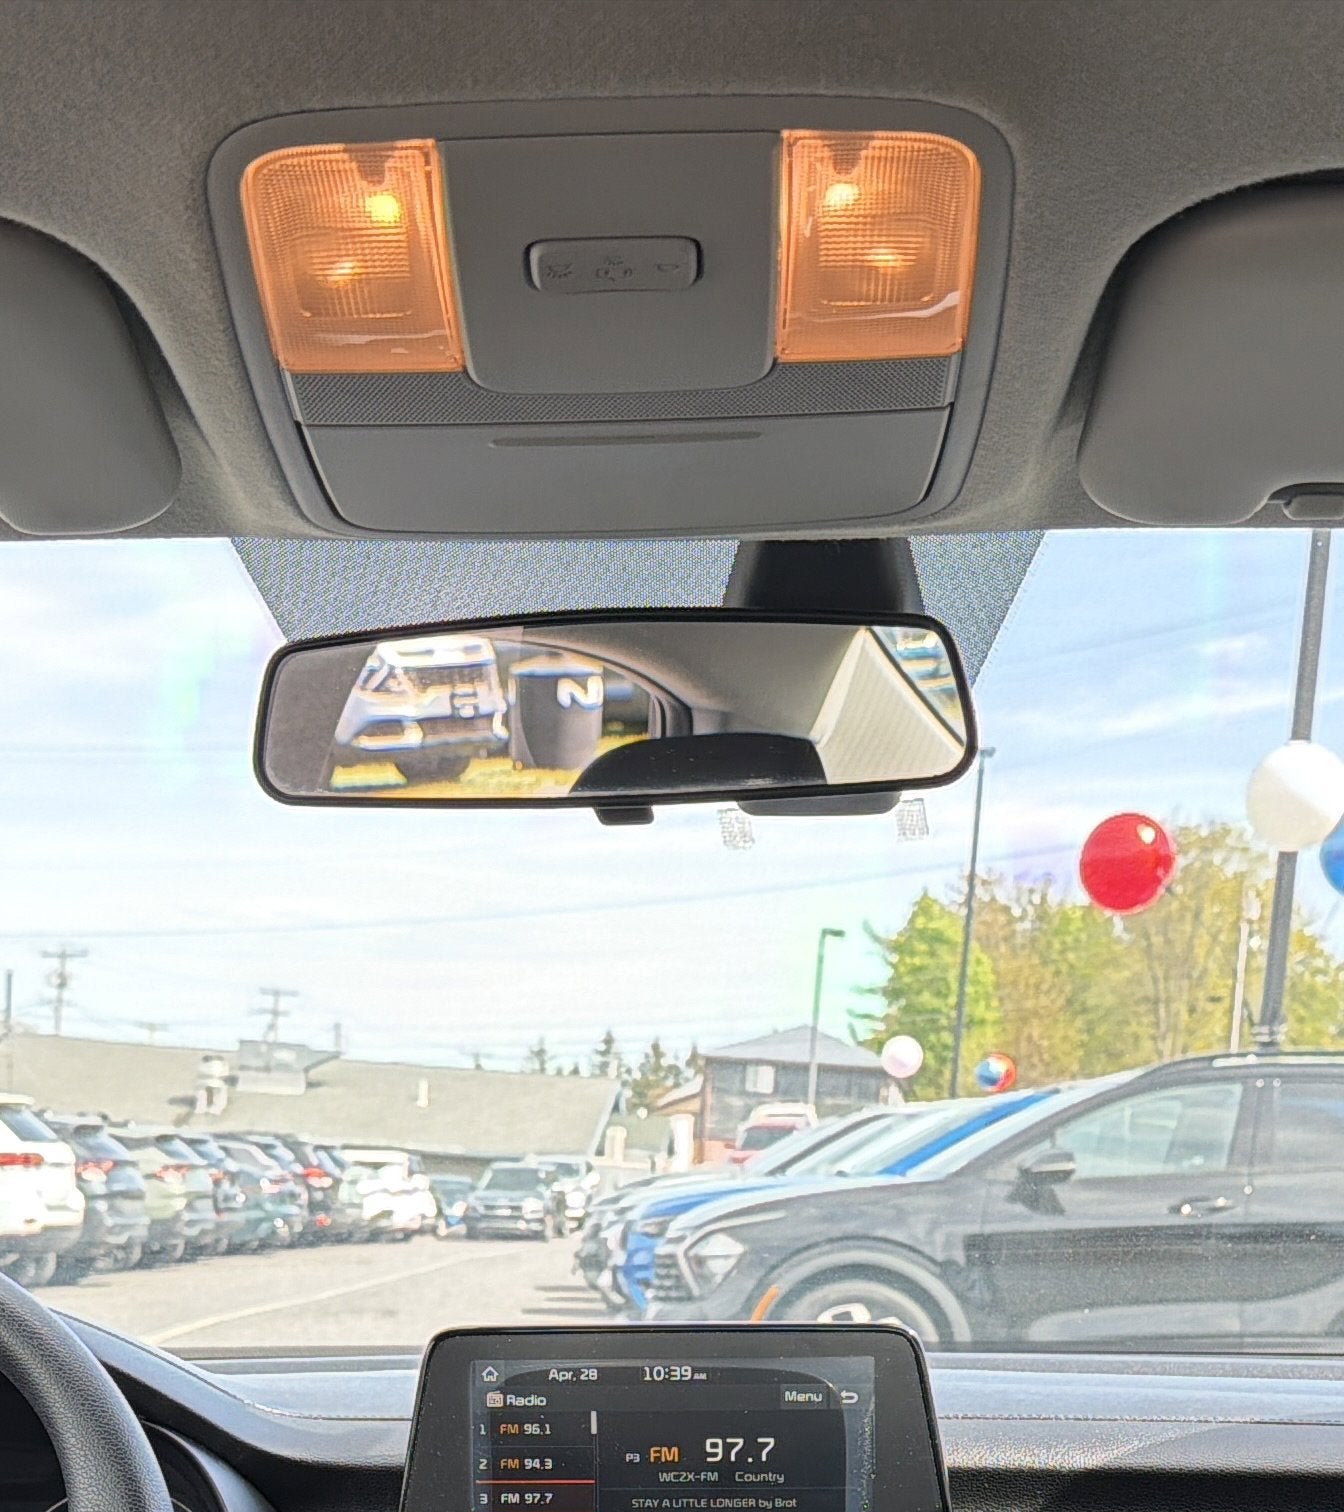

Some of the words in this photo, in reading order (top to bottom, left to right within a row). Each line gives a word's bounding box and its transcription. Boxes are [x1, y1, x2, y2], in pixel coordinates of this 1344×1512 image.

[579, 1367, 599, 1381] 28
[642, 1366, 692, 1381] 10:39
[506, 1394, 547, 1407] Radio
[784, 1390, 822, 1403] Menu
[480, 1423, 486, 1435] 1
[500, 1423, 519, 1435] FM
[523, 1423, 551, 1436] 96.1
[626, 1453, 640, 1463] P3
[650, 1447, 679, 1463] FM
[705, 1438, 775, 1463] 97.7
[479, 1458, 487, 1470] 2
[500, 1458, 519, 1470] FM
[524, 1458, 552, 1471] 94.3
[735, 1471, 785, 1485] Country
[480, 1492, 487, 1504] 3
[500, 1492, 519, 1504] FM
[524, 1492, 553, 1505] 97.7
[631, 1497, 661, 1509] STAY
[663, 1497, 671, 1509] A
[673, 1497, 706, 1509] LITTLE
[709, 1497, 756, 1509] LONGER
[758, 1497, 772, 1511] by
[774, 1497, 797, 1509] Brot
